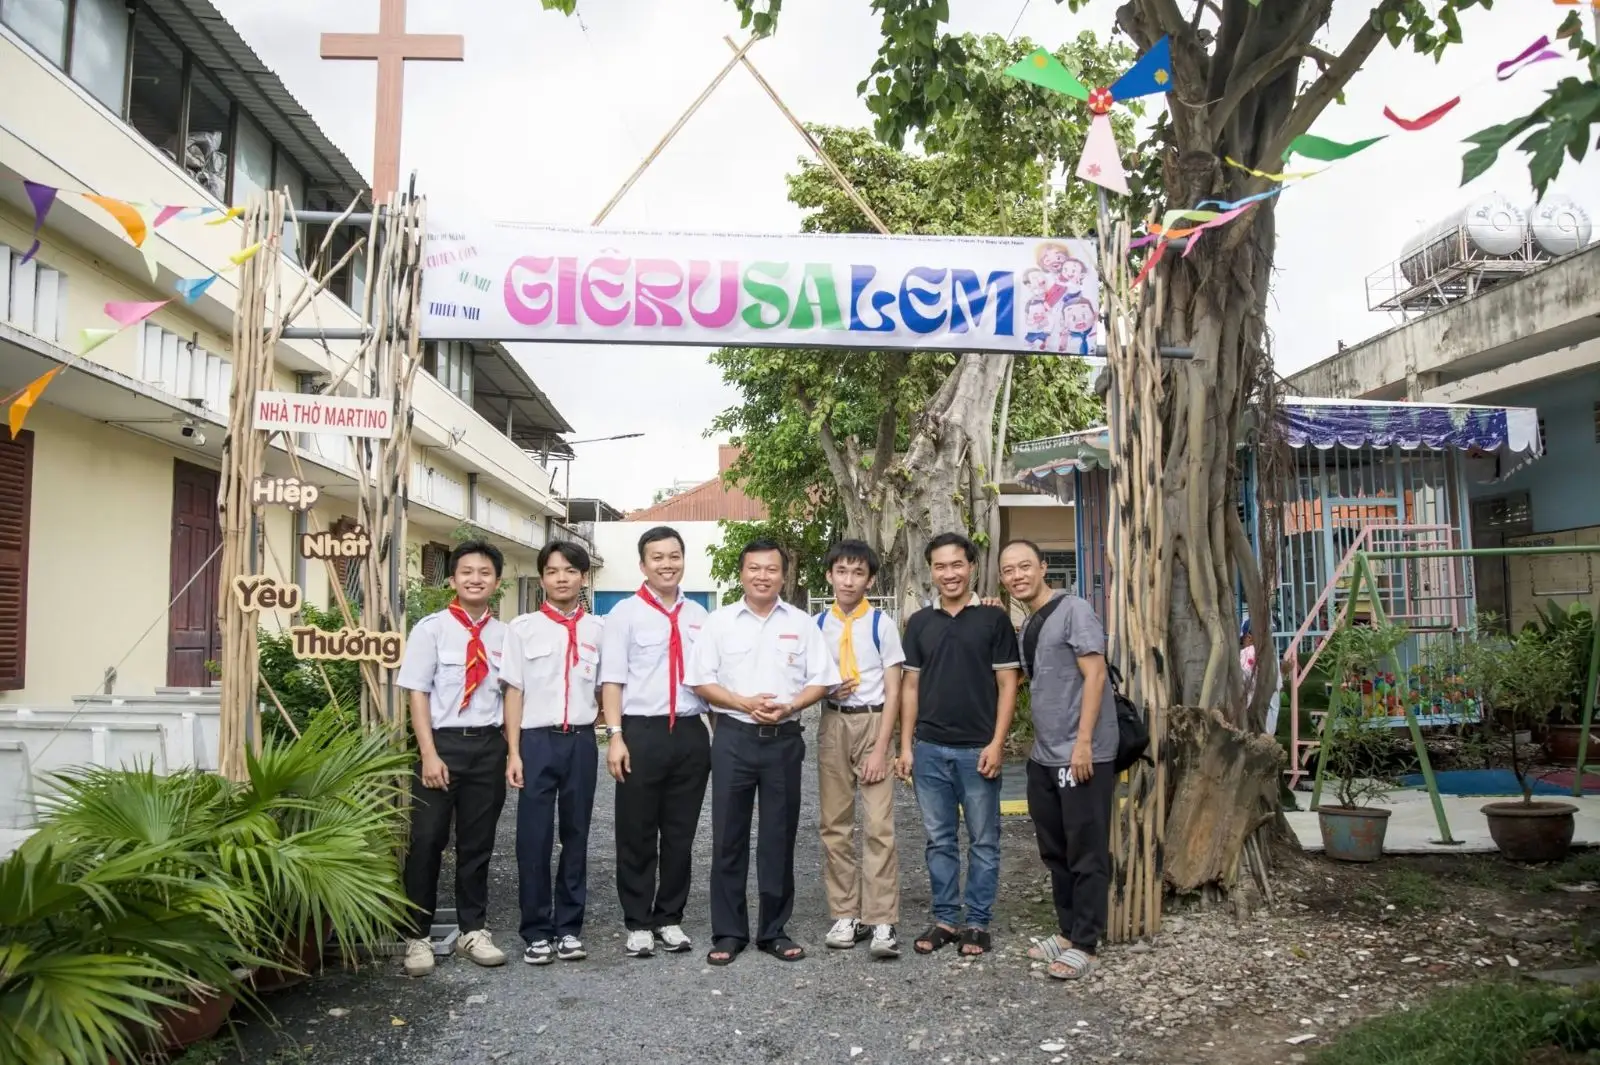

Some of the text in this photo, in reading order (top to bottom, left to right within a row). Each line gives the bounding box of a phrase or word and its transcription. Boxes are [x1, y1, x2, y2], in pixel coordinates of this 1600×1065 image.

[503, 247, 1015, 337] GIÊRUSALEM
[259, 399, 388, 429] NHÀ THỜ MARTINO
[253, 478, 319, 511] Hiệp
[303, 525, 371, 558] Nhất
[236, 578, 298, 609] Yêu
[292, 628, 401, 664] Thương
[1058, 766, 1077, 788] 94
